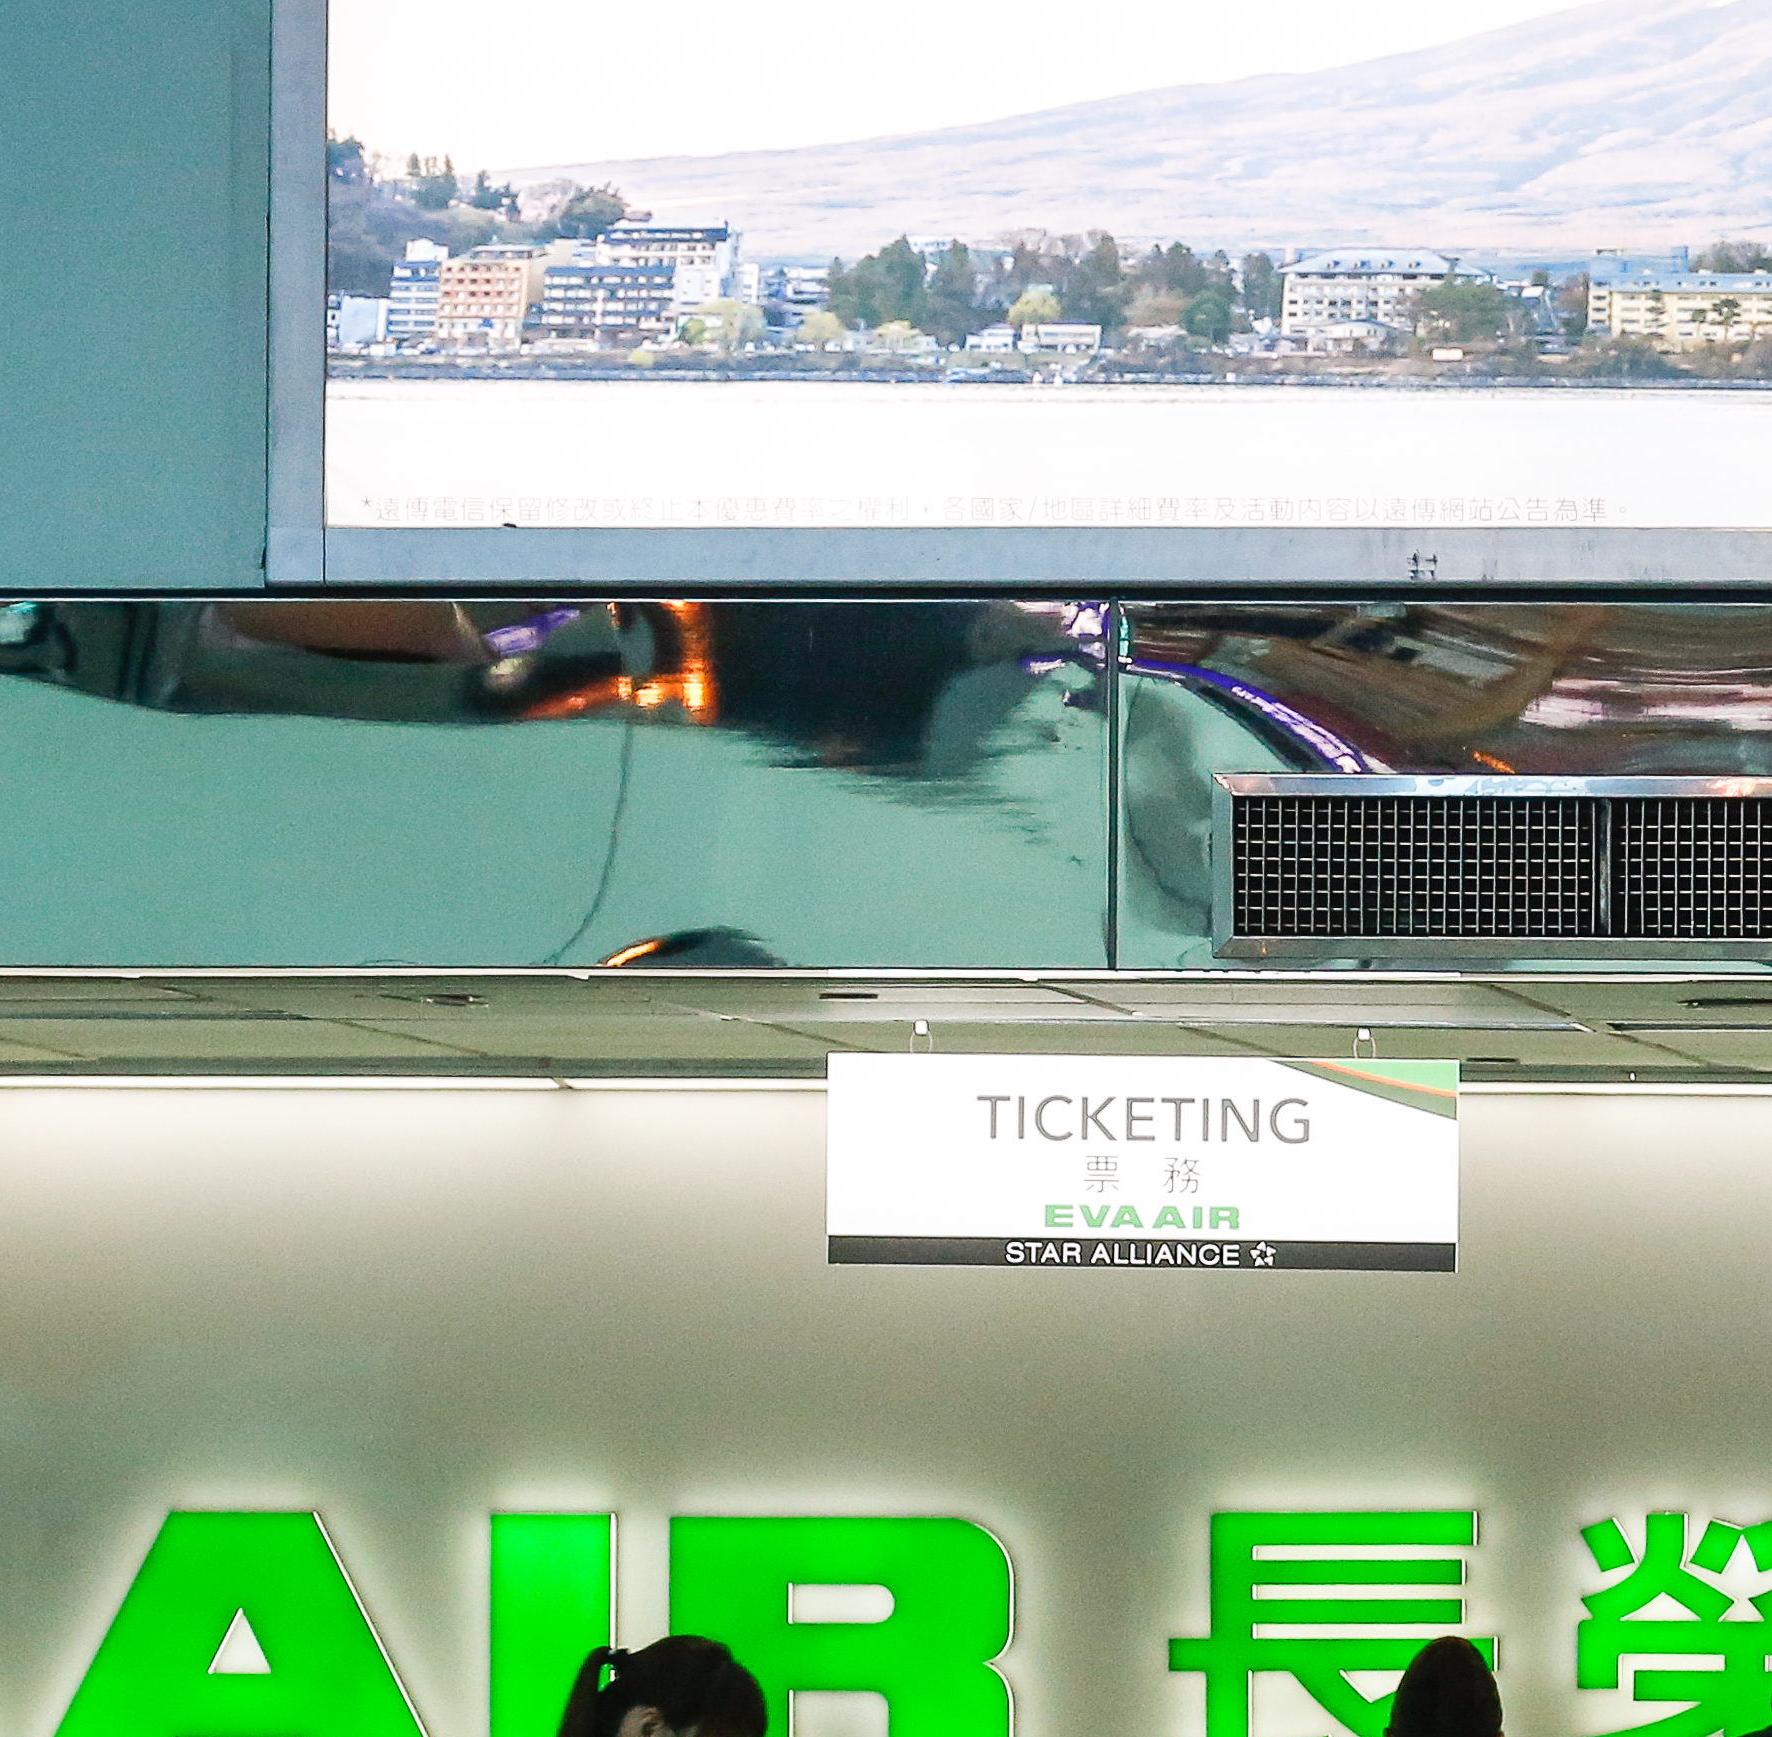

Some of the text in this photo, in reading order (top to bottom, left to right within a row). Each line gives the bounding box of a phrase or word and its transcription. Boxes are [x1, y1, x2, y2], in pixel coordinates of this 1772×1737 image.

[977, 1095, 1309, 1144] TICKETING
[1005, 1242, 1241, 1266] STAR ALLIANCE
